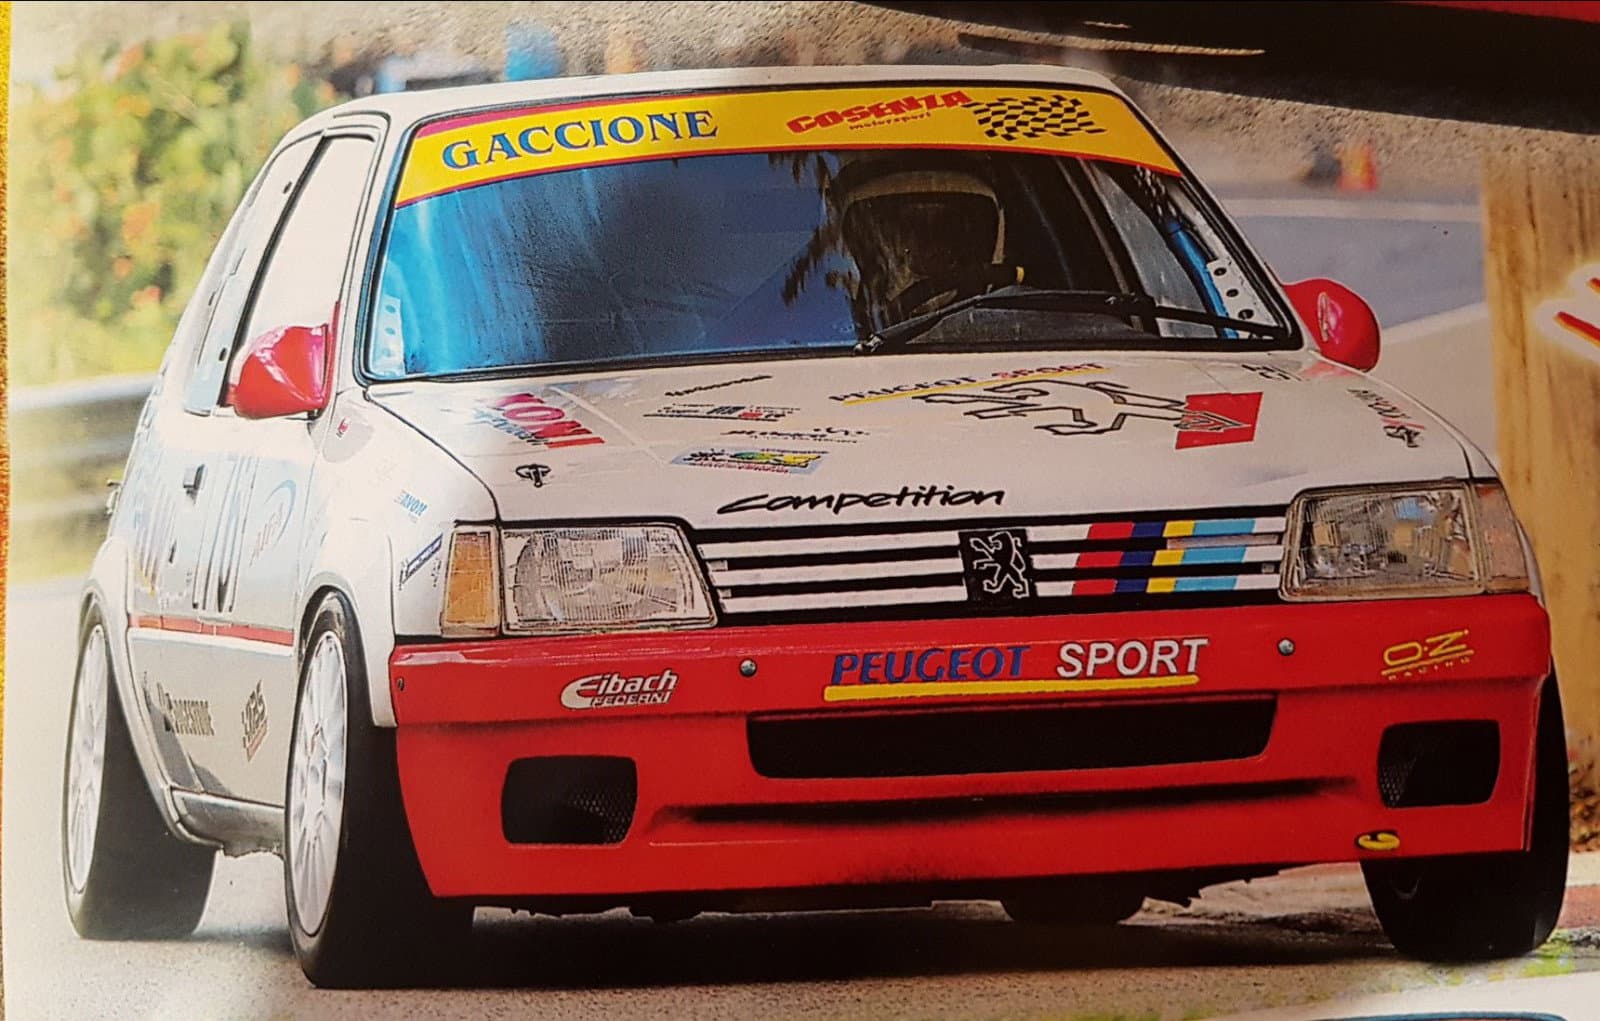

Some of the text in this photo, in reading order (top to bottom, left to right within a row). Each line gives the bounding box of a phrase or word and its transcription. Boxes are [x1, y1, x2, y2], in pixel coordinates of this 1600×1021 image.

[786, 89, 973, 134] COSENZA
[849, 111, 931, 130] motorsport
[442, 109, 719, 169] GACCIONE
[716, 485, 1005, 515] competition
[831, 637, 1209, 685] PEUGEOT SPORT
[561, 669, 680, 710] Eibach
